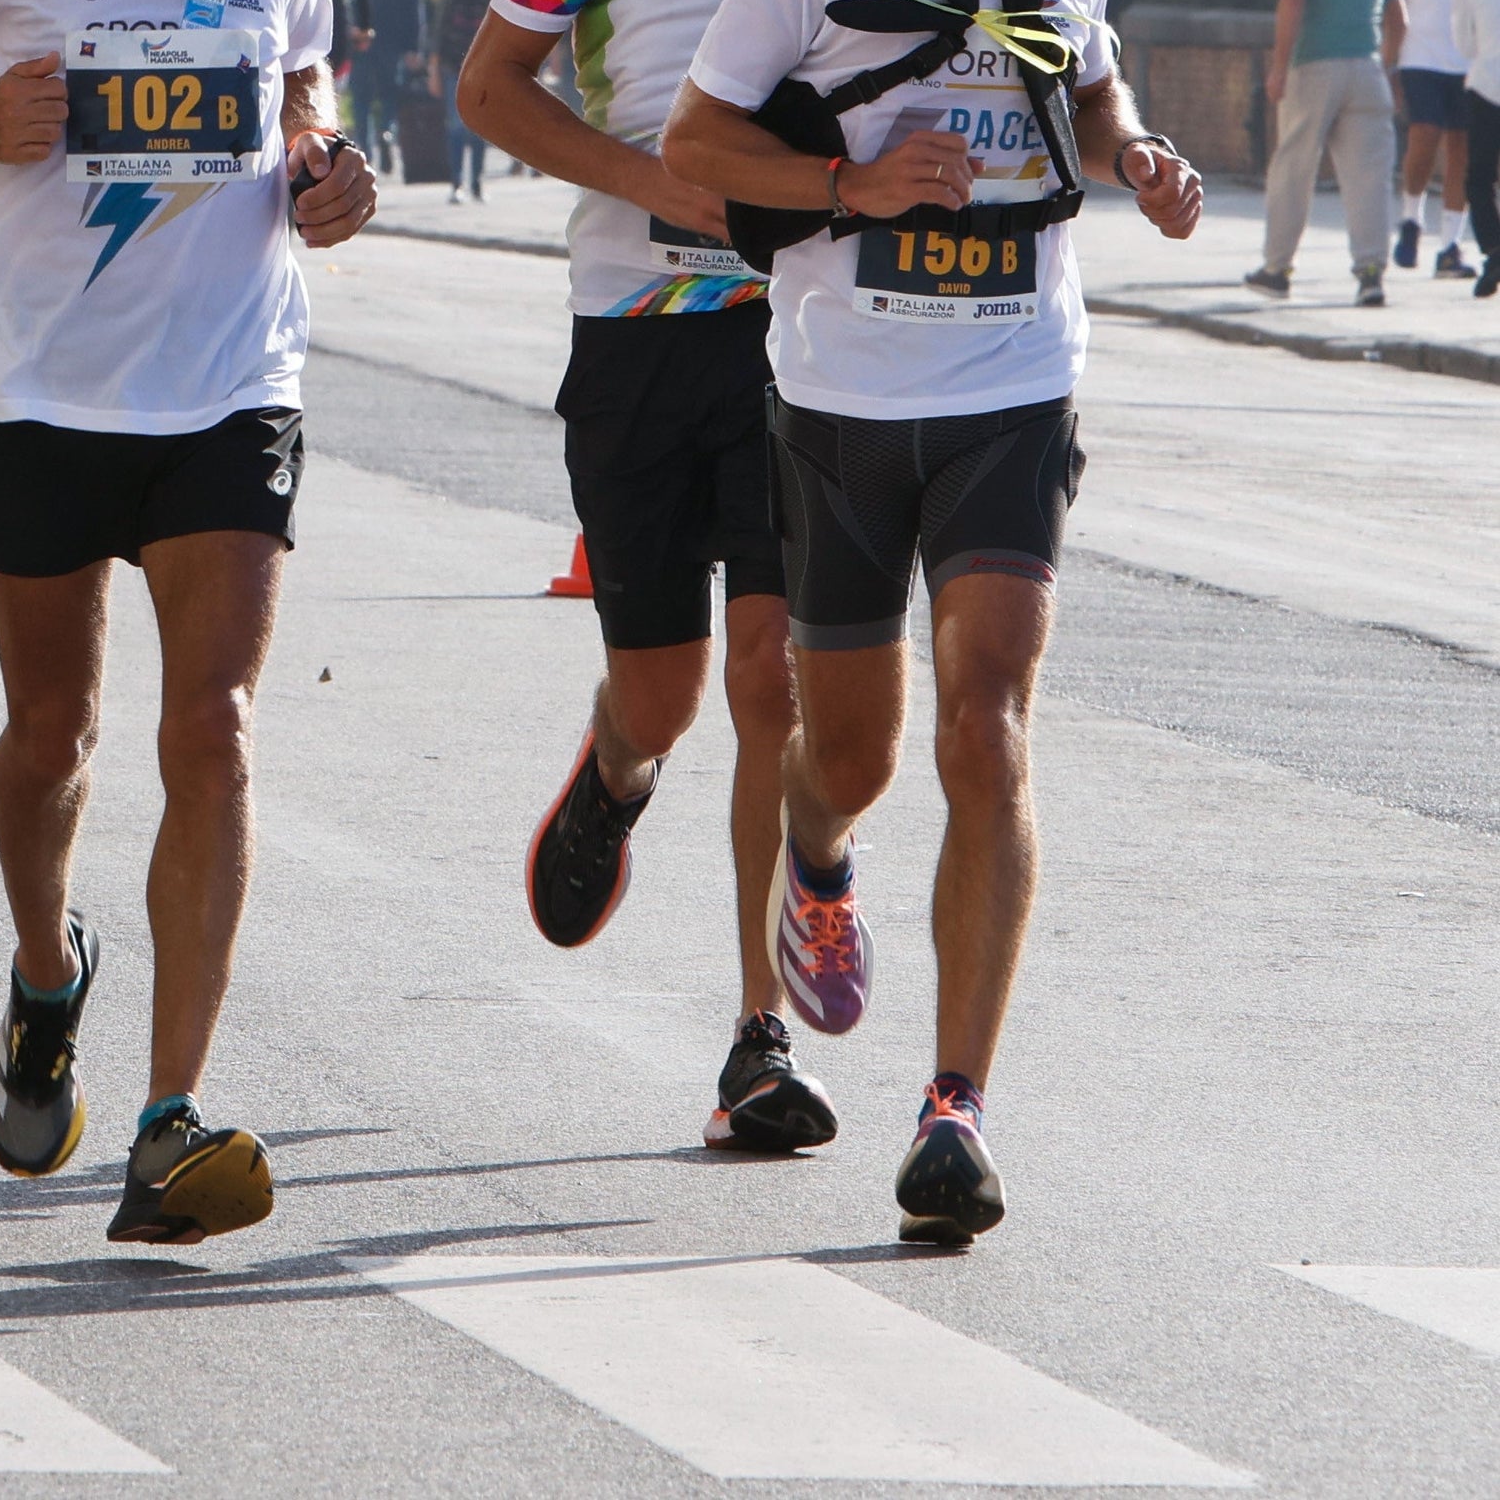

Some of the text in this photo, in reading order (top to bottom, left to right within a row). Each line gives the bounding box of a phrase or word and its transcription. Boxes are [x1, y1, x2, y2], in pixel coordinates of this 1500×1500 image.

[228, 1, 264, 13] MARATHON
[906, 78, 941, 88] ILANO
[98, 74, 239, 131] 102 B
[949, 108, 1042, 151] PACE
[146, 138, 191, 150] ANDREA
[104, 159, 172, 170] ITALIANA
[104, 169, 172, 177] ASSICURAZIONI
[682, 252, 744, 265] ITALIANA
[1002, 240, 1018, 275] B
[681, 261, 744, 271] ASSICURAZIONI
[938, 282, 971, 295] DAVID
[890, 298, 955, 311] ITALIANA
[890, 307, 955, 319] ASSICURAZIONI
